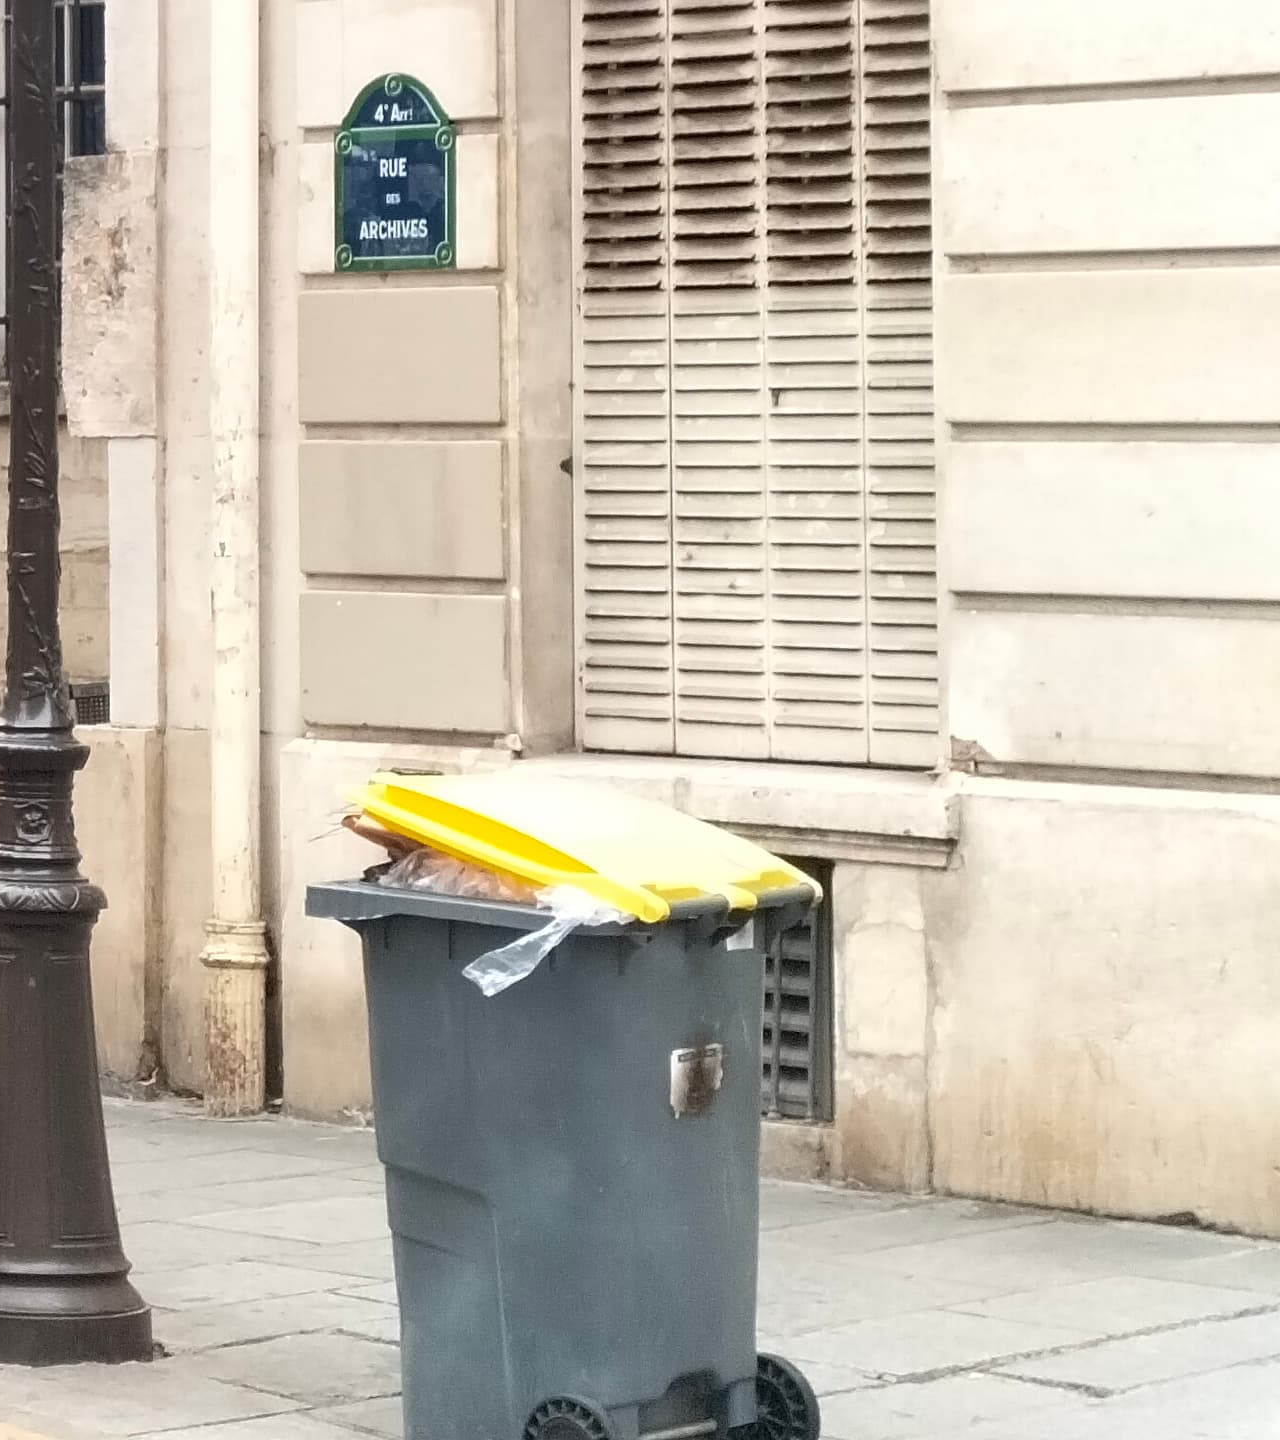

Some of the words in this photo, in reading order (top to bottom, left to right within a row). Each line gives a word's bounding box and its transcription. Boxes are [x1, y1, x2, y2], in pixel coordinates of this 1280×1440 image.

[379, 157, 408, 178] RUE
[385, 193, 401, 205] DES
[359, 218, 429, 240] ARCHIVES
